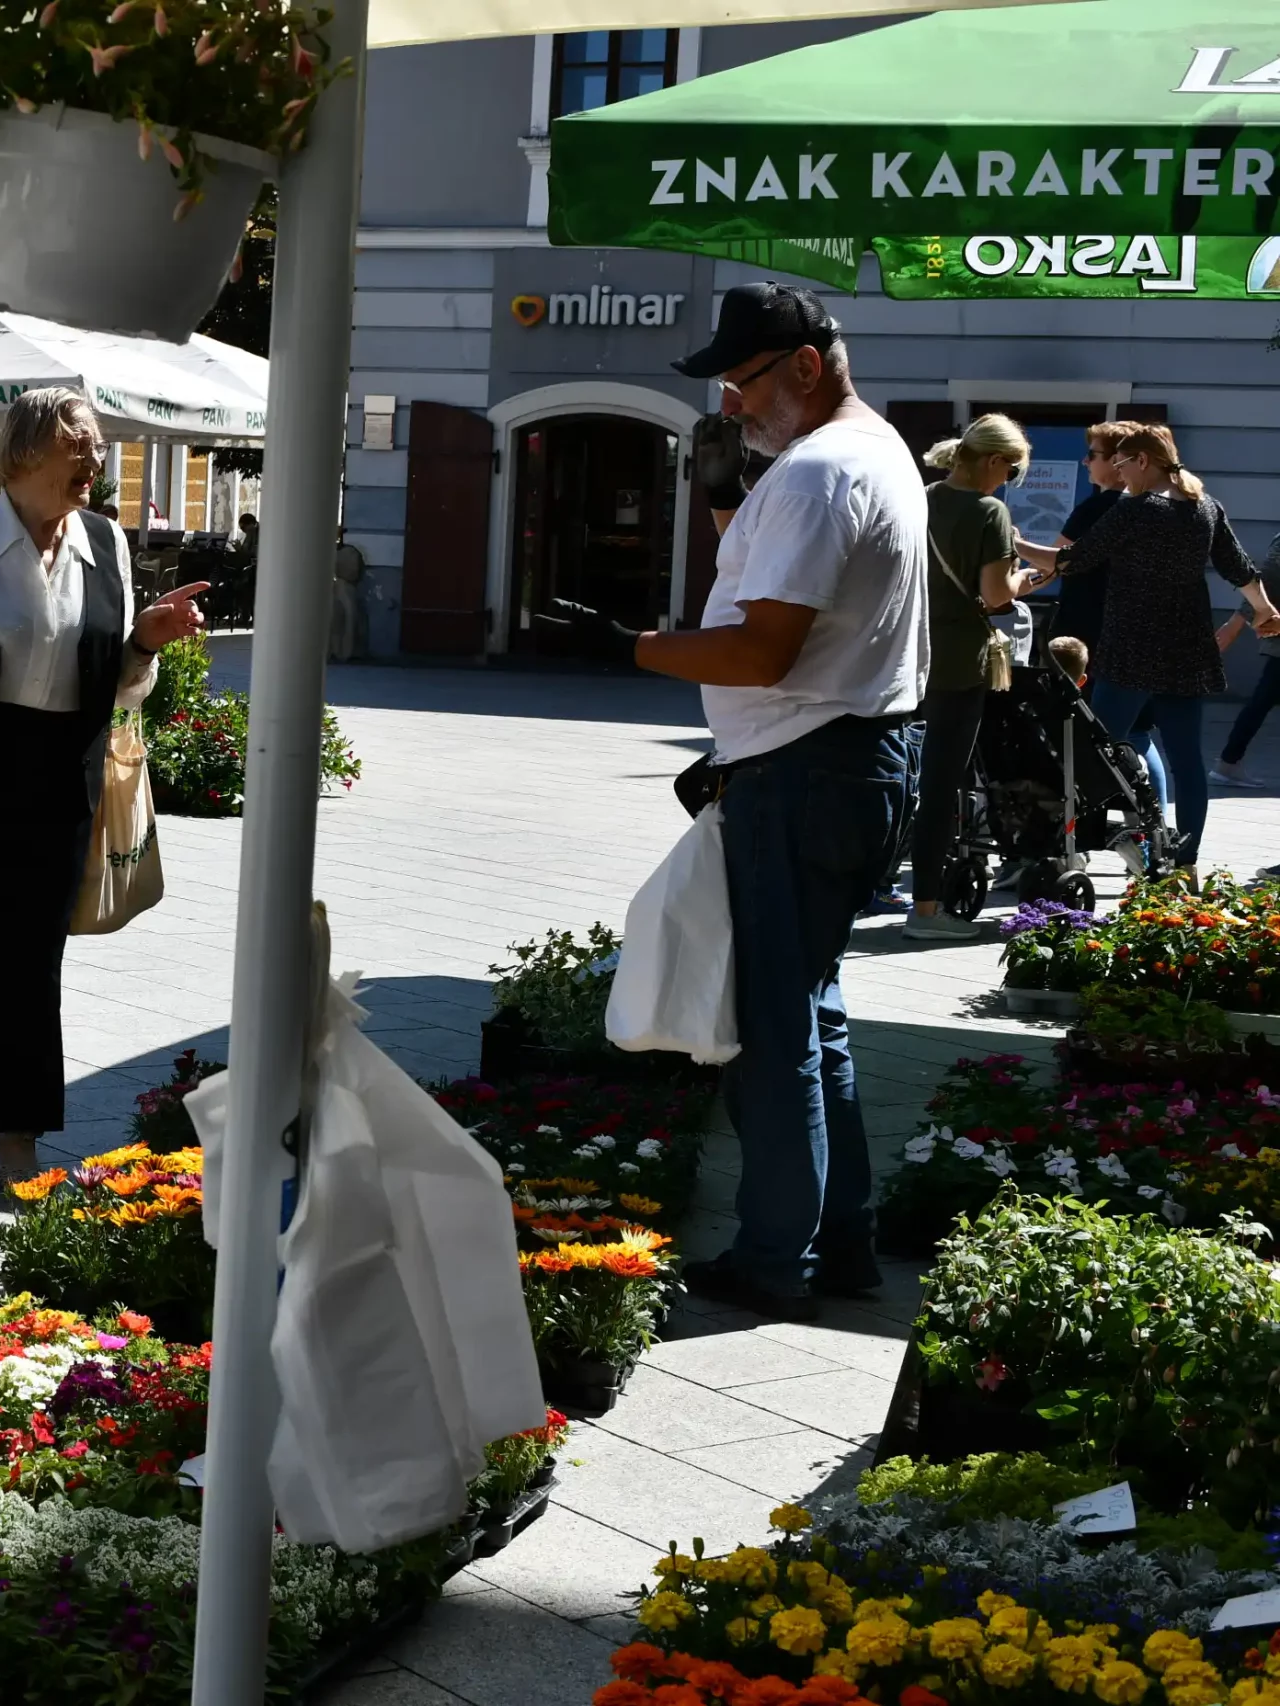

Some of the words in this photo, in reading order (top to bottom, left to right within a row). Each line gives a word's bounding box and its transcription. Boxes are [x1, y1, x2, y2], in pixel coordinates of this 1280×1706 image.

[649, 154, 839, 205] ZNAK
[872, 148, 1276, 198] KARAKTER
[548, 284, 686, 326] mlinar
[147, 398, 175, 421] PAN
[202, 408, 226, 428] PAN
